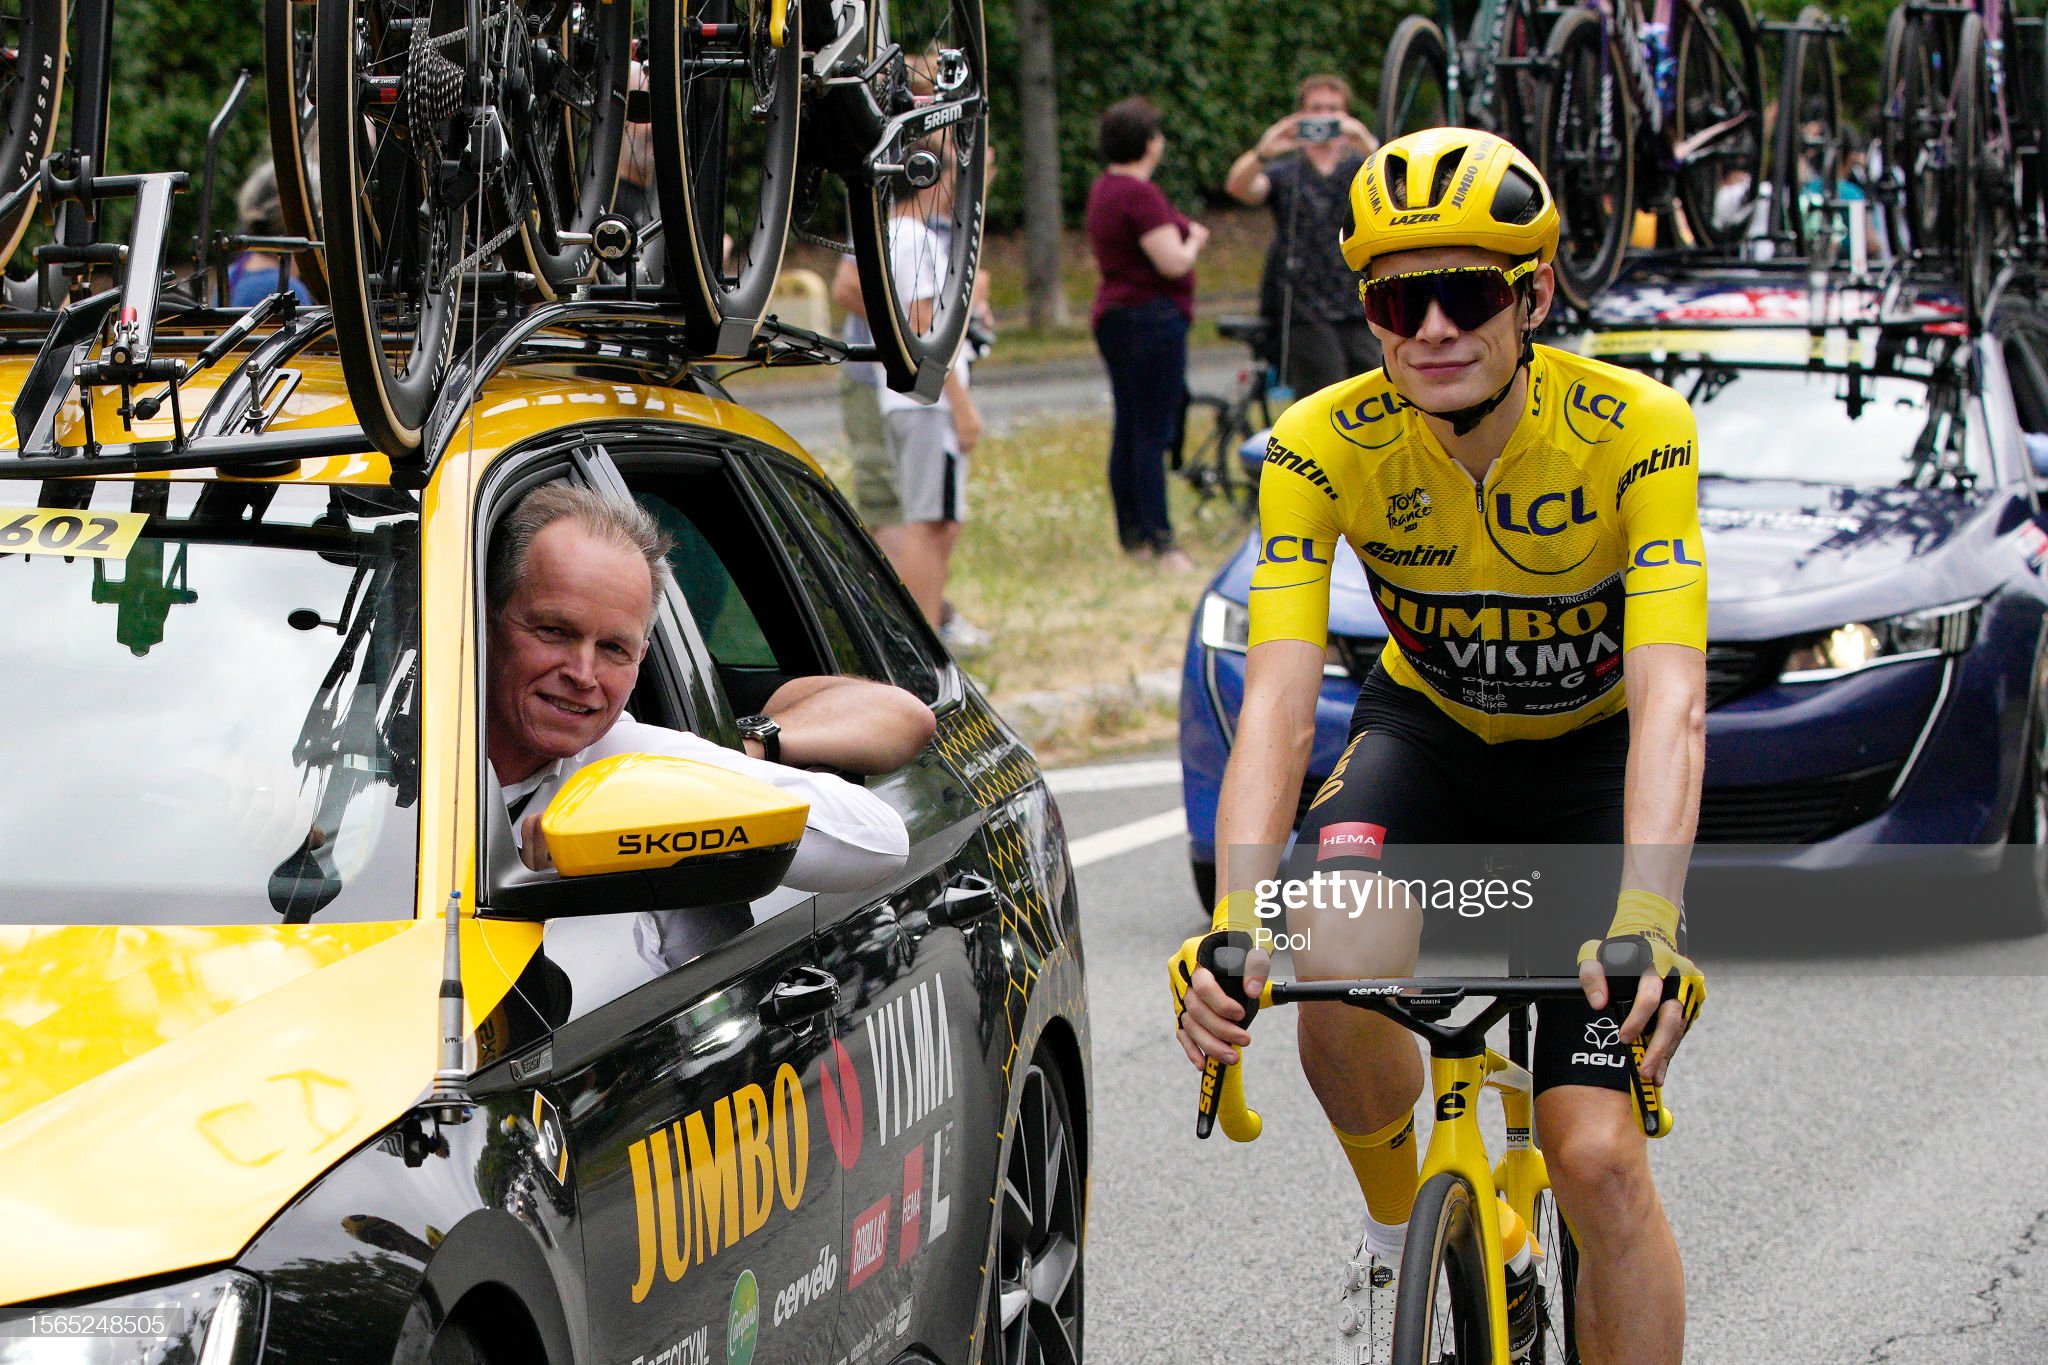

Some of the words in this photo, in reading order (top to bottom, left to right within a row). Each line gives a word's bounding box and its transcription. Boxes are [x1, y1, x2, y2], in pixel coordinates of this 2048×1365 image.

[20, 54, 53, 181] RESERVE
[924, 104, 963, 132] SRAM
[1367, 185, 1383, 216] VISMA
[1450, 165, 1479, 211] JUMBO
[1389, 213, 1441, 227] LAZER
[1335, 391, 1403, 431] LCL
[1532, 371, 1544, 417] LCL
[1572, 384, 1628, 430] LCL
[1263, 436, 1339, 501] Santin
[1496, 485, 1598, 537] LCL
[0, 514, 119, 552] 602
[1361, 541, 1459, 568] Santini
[1559, 573, 1620, 606] VINGEGAARD
[1376, 584, 1608, 642] JUMBO
[1444, 631, 1619, 676] VISMA
[1525, 694, 1588, 710] SRAM
[617, 826, 749, 855] SKODA
[1323, 834, 1377, 847] HEMA
[866, 973, 953, 1146] VISMA
[1571, 1053, 1626, 1068] AGU
[544, 1119, 558, 1157] 8
[629, 1063, 809, 1304] JUMBO
[902, 1188, 921, 1225] HEMA
[853, 1210, 886, 1276] GORILLAS
[774, 1244, 838, 1328] cervélo
